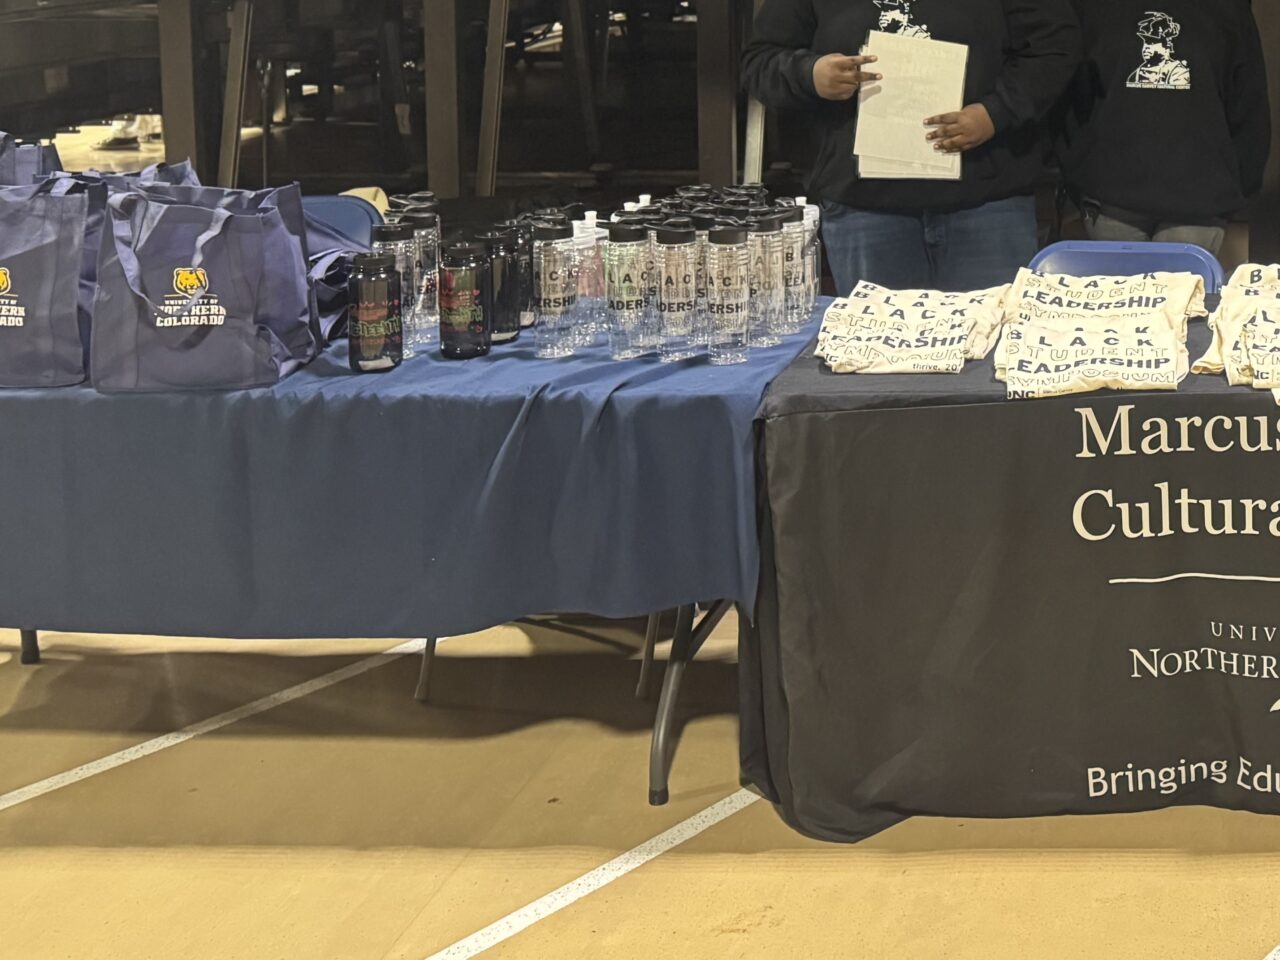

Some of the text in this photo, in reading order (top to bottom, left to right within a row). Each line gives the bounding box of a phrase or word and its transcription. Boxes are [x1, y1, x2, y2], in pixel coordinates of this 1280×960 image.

[1022, 290, 1167, 311] LEADERSHIP
[156, 315, 225, 327] COLORADO
[912, 363, 941, 371] thrive.
[1087, 757, 1229, 798] Bringing
